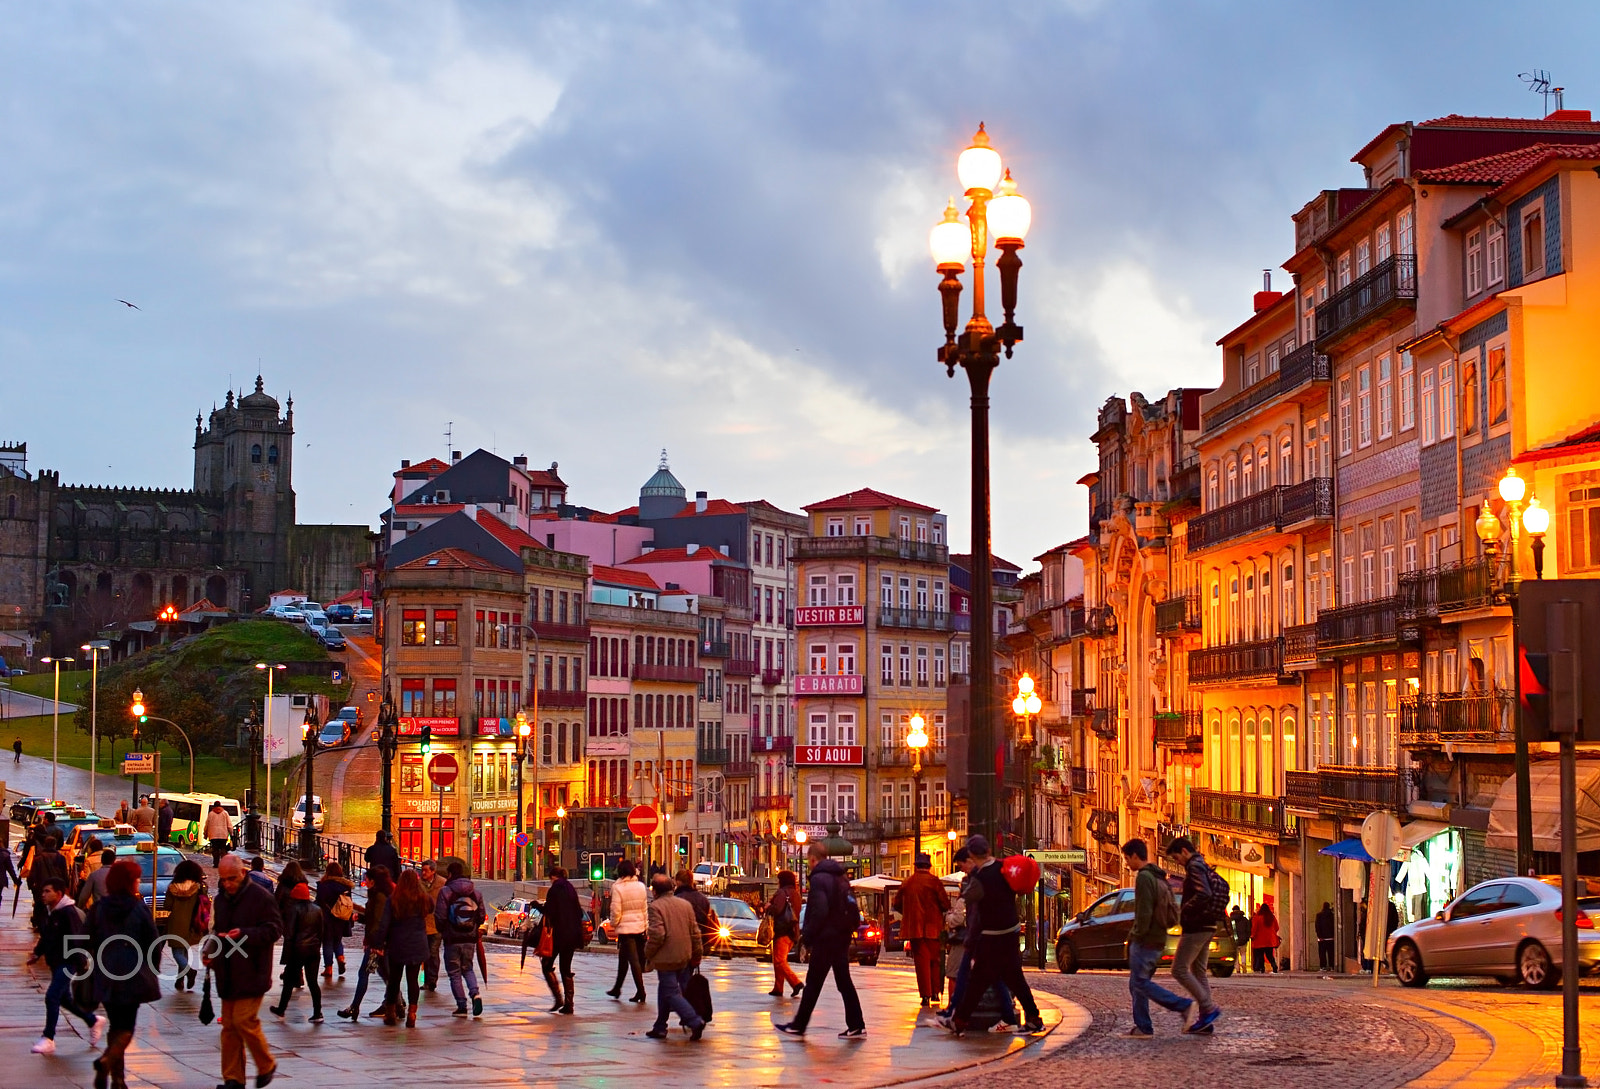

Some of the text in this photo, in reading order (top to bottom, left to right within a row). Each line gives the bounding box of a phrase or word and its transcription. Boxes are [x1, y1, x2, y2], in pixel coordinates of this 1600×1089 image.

[797, 608, 862, 622] VESTIR BEM
[800, 678, 857, 691] E BARATO
[806, 746, 851, 762] SÓ AQUI
[473, 799, 518, 810] TOURIST SERVIC
